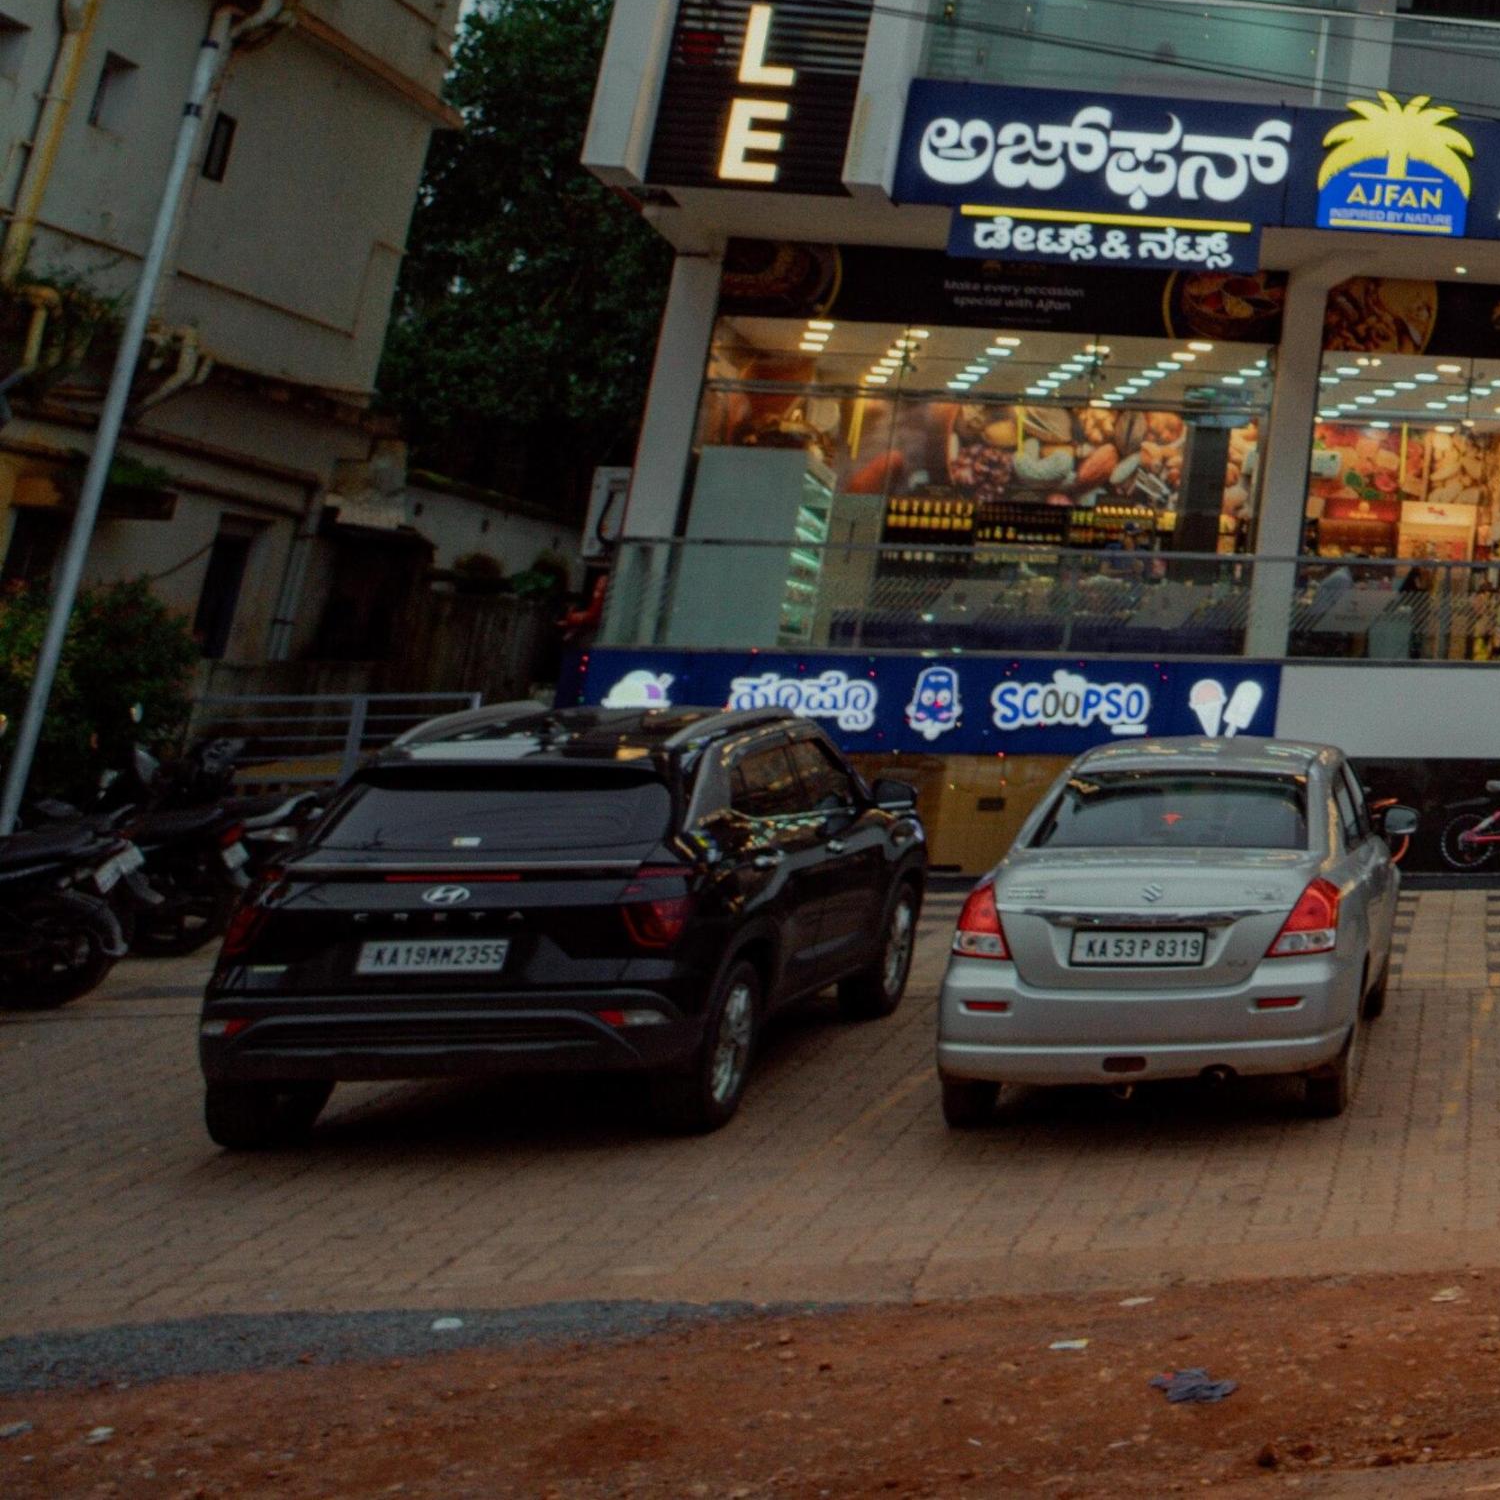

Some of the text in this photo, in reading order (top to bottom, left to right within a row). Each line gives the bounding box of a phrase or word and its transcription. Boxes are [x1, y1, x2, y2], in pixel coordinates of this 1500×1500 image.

[1345, 181, 1444, 210] AJFAN
[1403, 211, 1453, 226] NATURE
[1100, 232, 1133, 261] &
[993, 682, 1149, 727] SCOOPSO
[352, 910, 526, 922] CRETA
[1085, 938, 1201, 959] KA 53 P 8319
